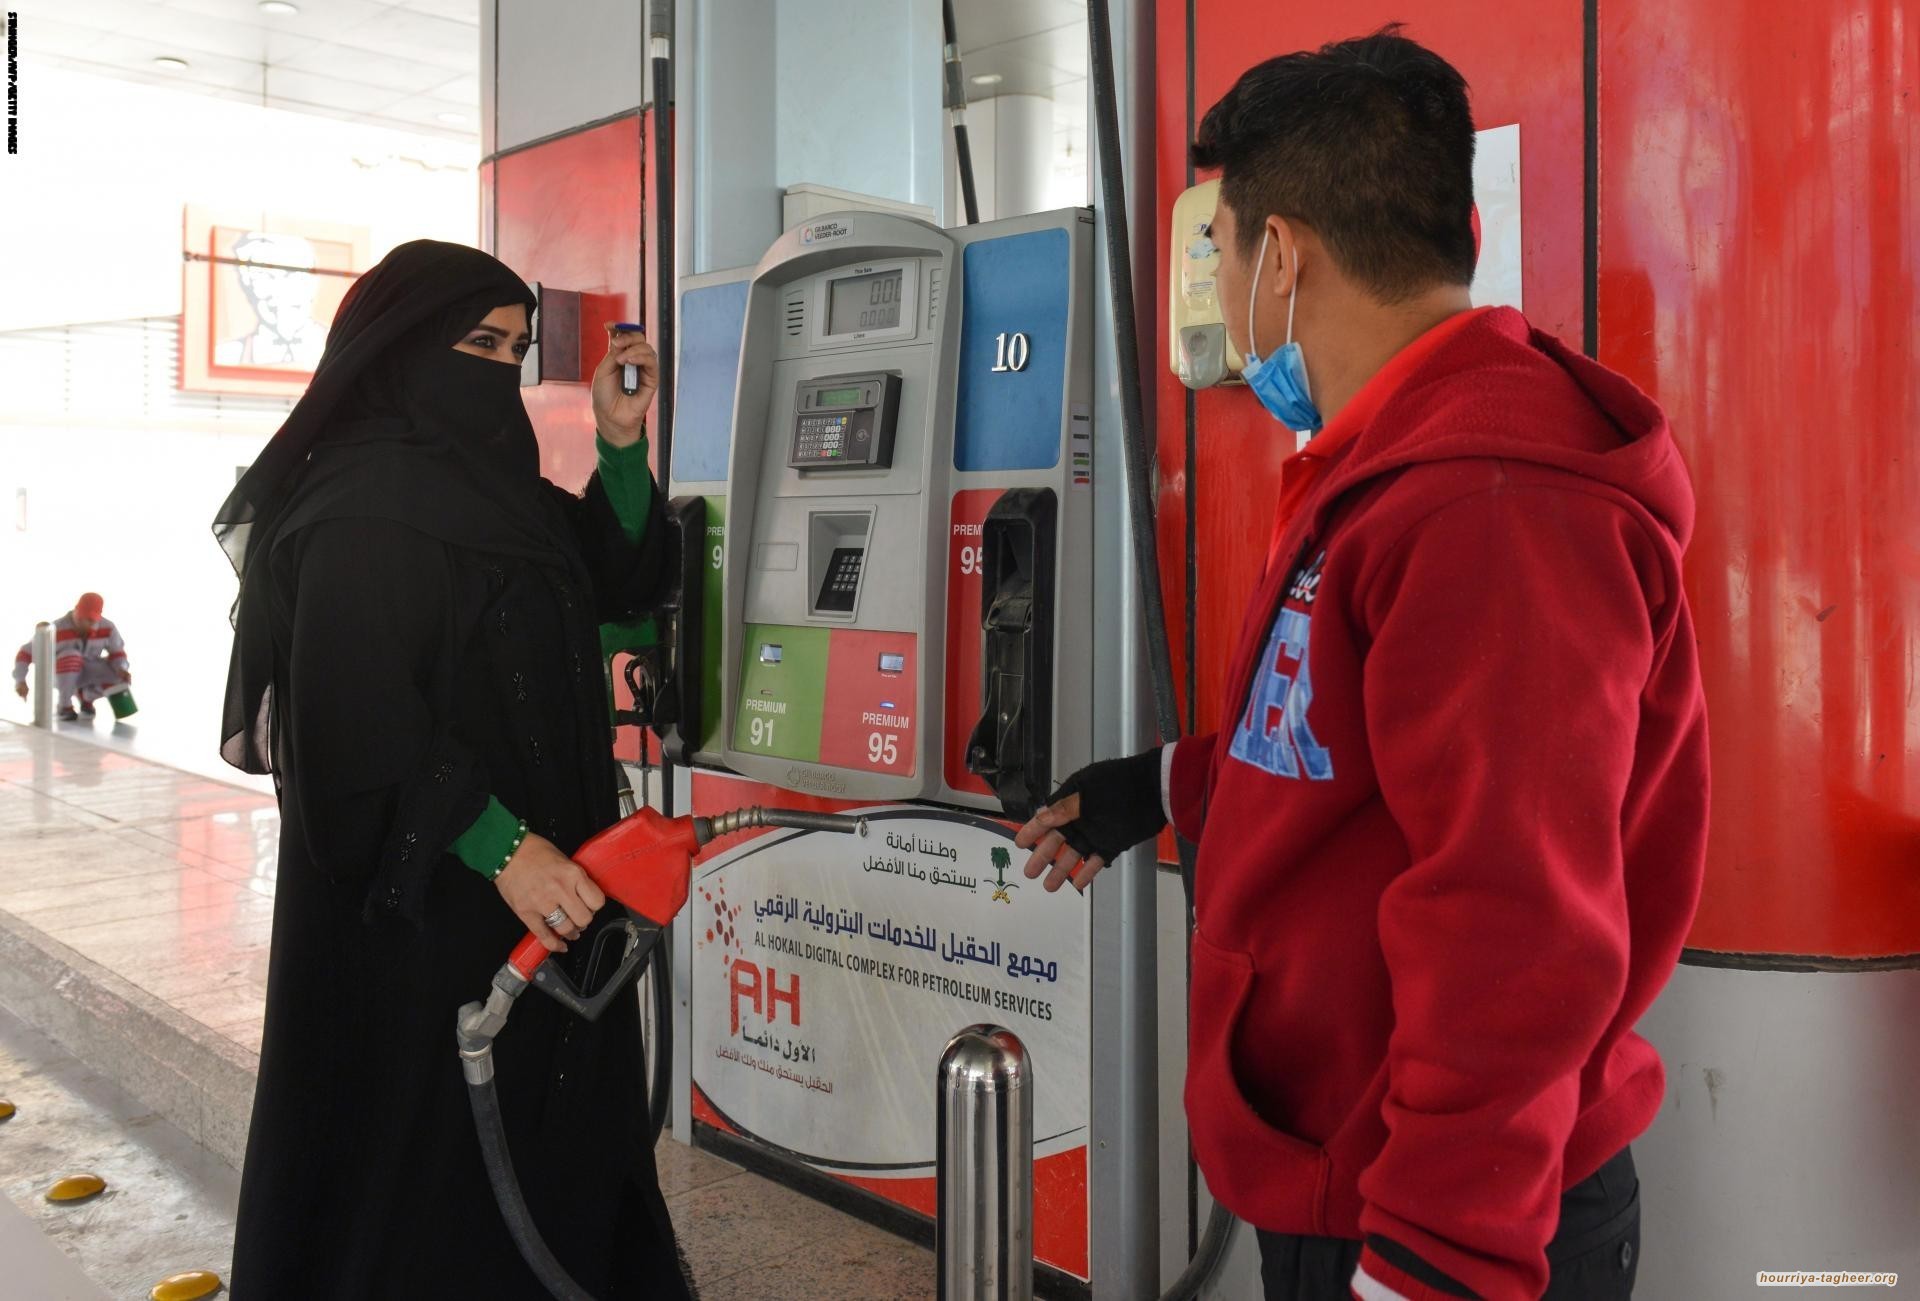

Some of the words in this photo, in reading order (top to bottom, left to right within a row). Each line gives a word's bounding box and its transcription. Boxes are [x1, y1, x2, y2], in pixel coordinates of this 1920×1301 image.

[991, 332, 1029, 371] 10
[746, 698, 787, 715] PREMIUM
[862, 711, 909, 729] PREMIUM
[750, 717, 774, 747] 91
[868, 731, 898, 765] 95
[886, 831, 915, 853] أمانة
[863, 855, 905, 876] الأفضل
[907, 861, 926, 881] منا
[929, 866, 977, 894] يستحق
[754, 894, 798, 923] الرقمي
[803, 901, 863, 939] البترولية
[868, 918, 937, 952] للخدمات
[941, 932, 1000, 966] الحقيل
[755, 931, 765, 947] AL
[768, 934, 803, 957] HOKAIL
[805, 943, 844, 968] DIGITAL
[846, 954, 895, 981] COMPLEX
[898, 966, 919, 987] FOR
[922, 972, 991, 1006] PETROLEUM
[994, 990, 1053, 1021] SERVICES
[1006, 952, 1058, 983] مجمع
[730, 958, 800, 1037] AH
[776, 1064, 803, 1087] يستحق
[805, 1075, 833, 1094] الحقيل
